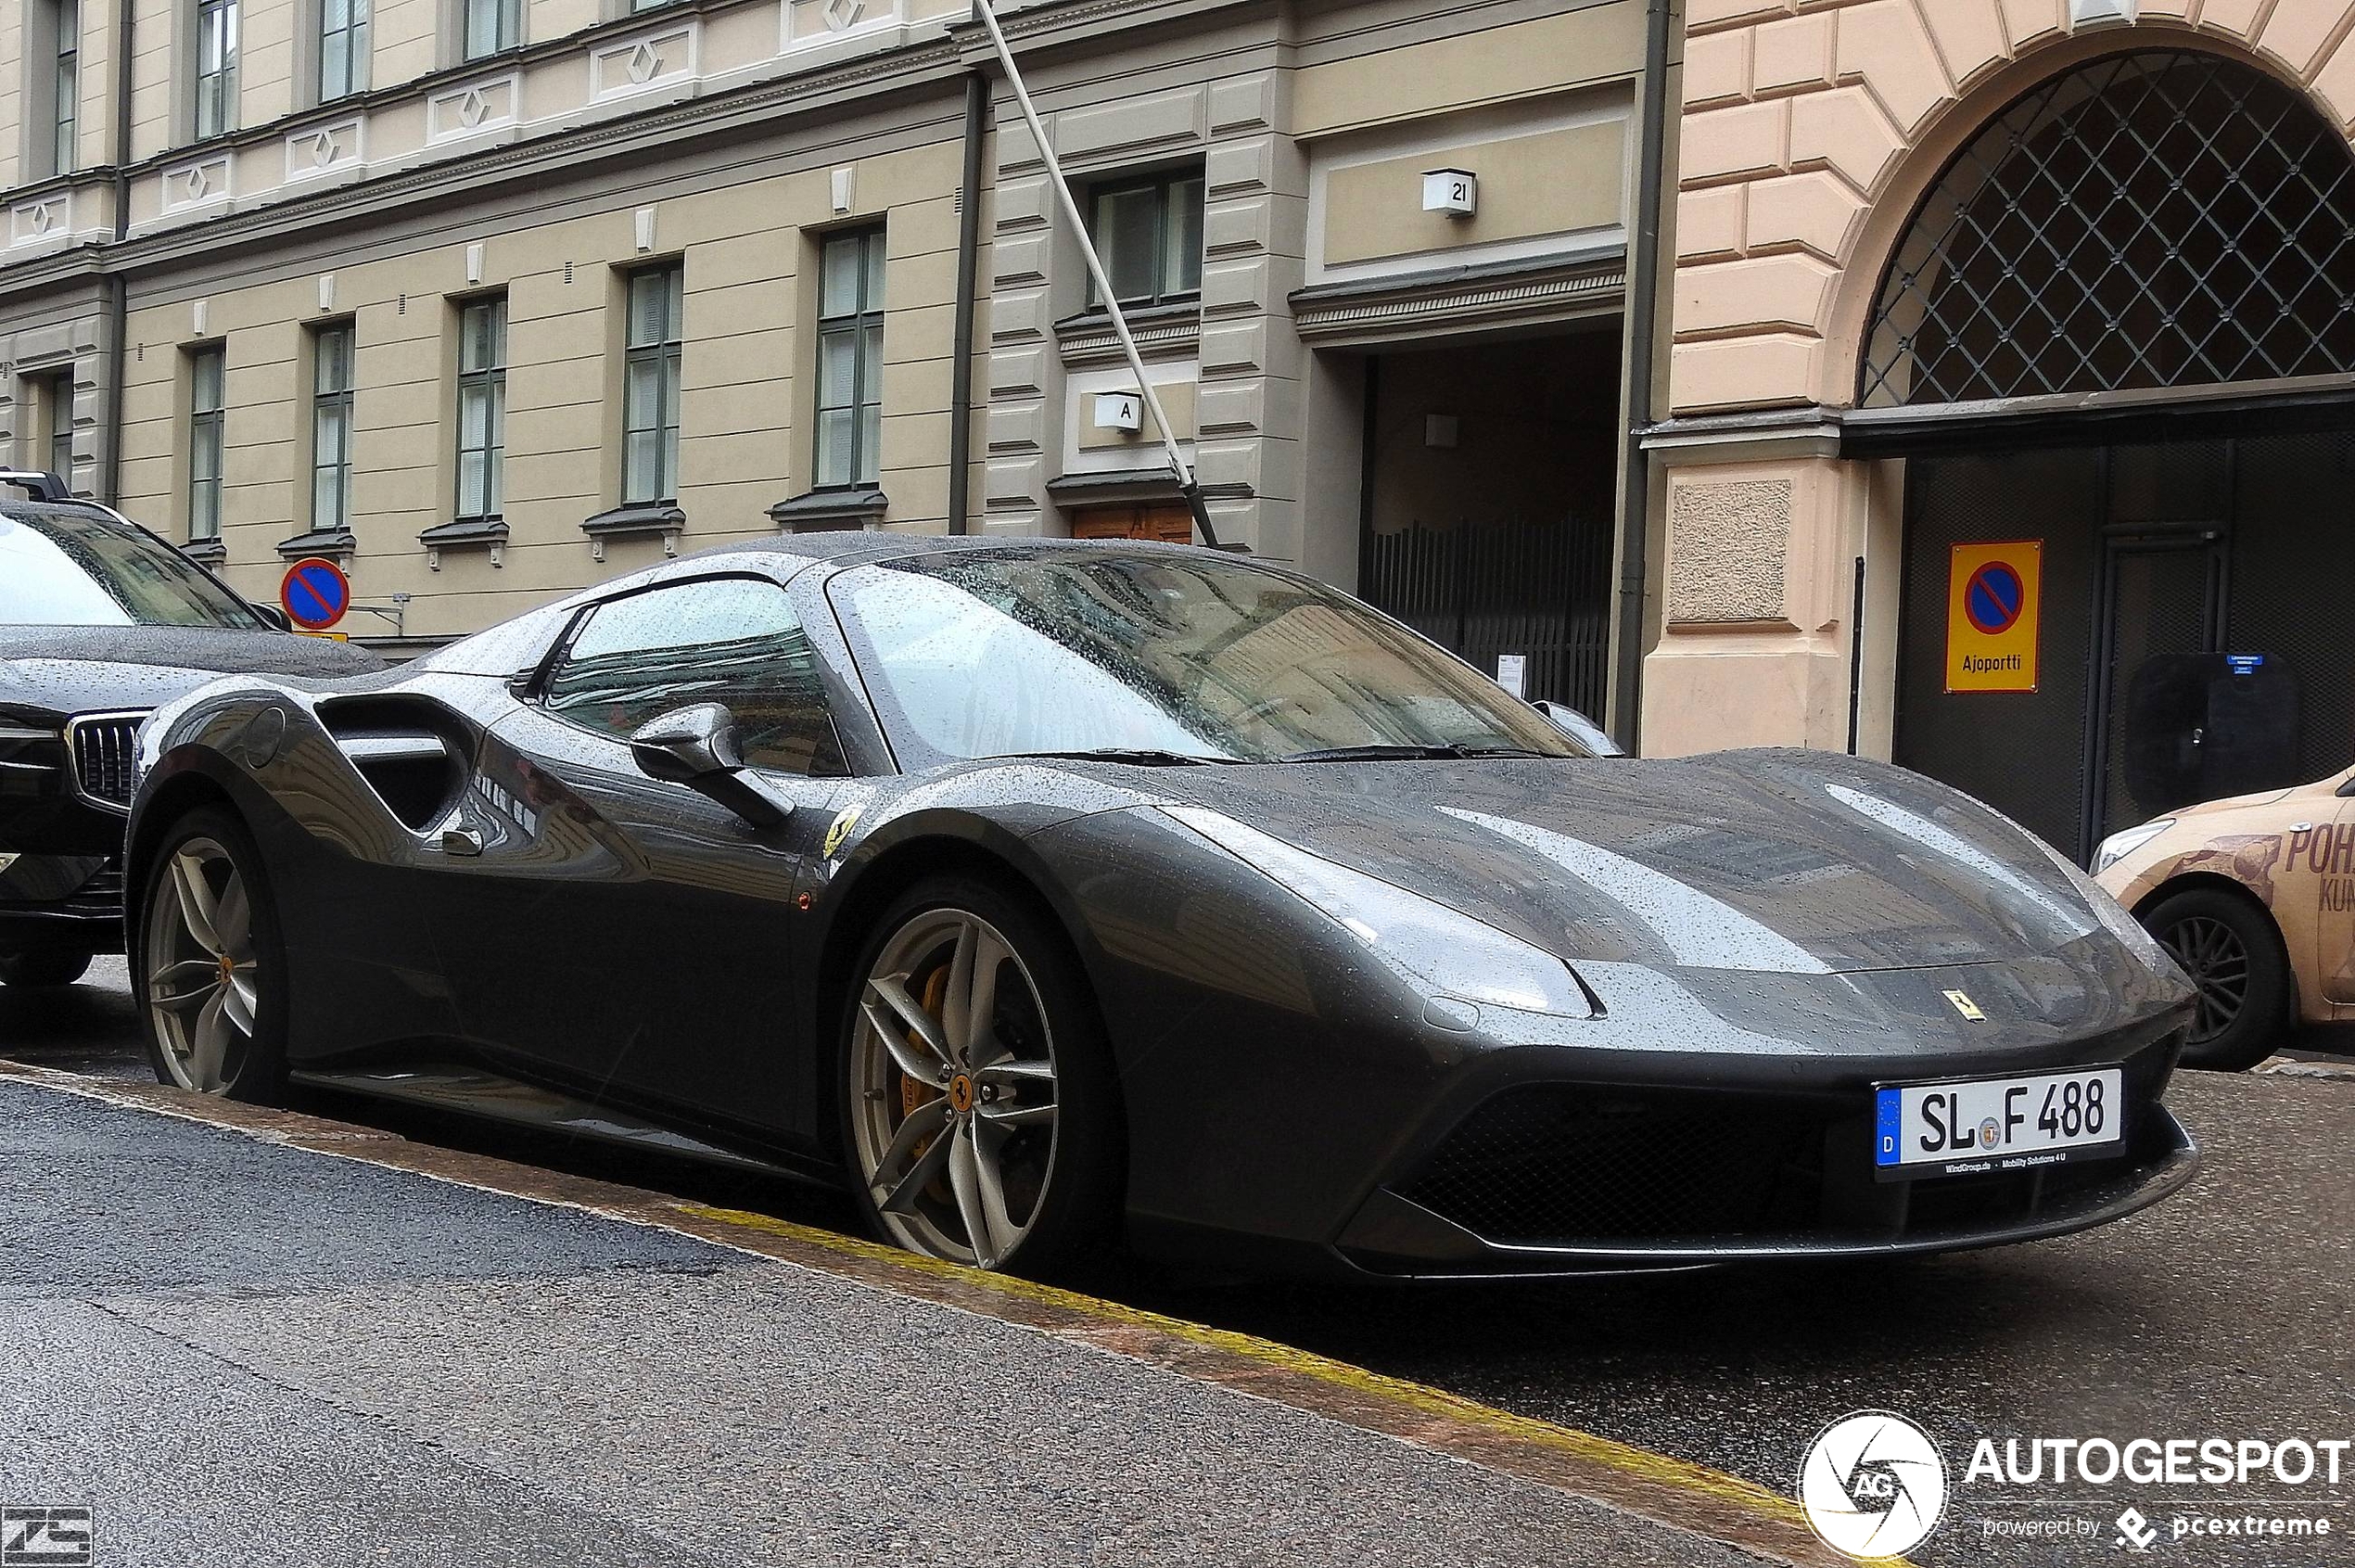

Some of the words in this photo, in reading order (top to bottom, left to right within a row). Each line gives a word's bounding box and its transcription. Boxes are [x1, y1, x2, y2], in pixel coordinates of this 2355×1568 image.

[1452, 182, 1467, 202] 21
[1120, 402, 1132, 419] A
[1962, 654, 2021, 674] Ajoportti
[2285, 822, 2355, 873] POH
[1919, 1092, 1976, 1153] SL
[2005, 1086, 2029, 1144] F
[2038, 1077, 2105, 1140] 488
[1883, 1136, 1894, 1154] D
[2002, 1158, 2027, 1168] Mobility
[2027, 1155, 2056, 1166] Solutions
